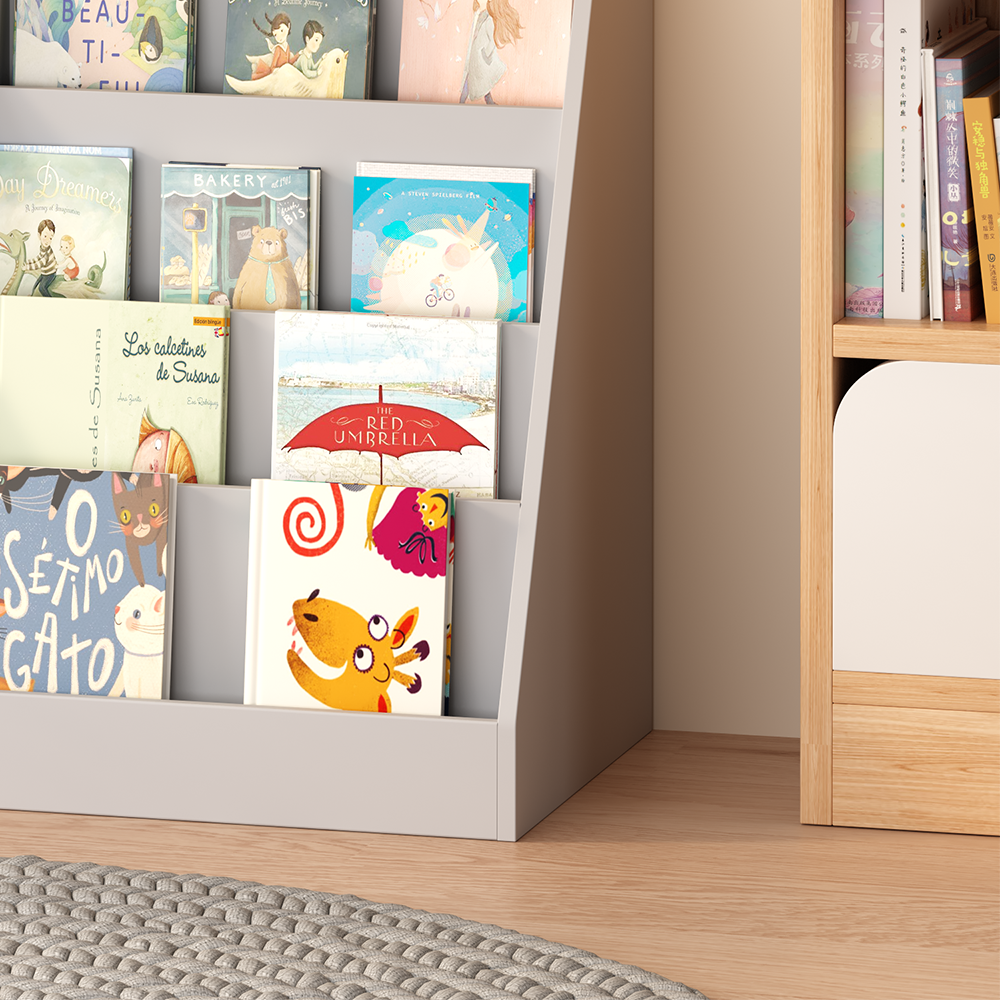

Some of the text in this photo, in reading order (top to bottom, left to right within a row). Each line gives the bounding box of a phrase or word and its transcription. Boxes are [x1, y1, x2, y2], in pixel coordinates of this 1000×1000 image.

[82, 39, 120, 63] TI-
[33, 160, 122, 214] Dreamers
[194, 174, 267, 188] BAKERY
[123, 331, 207, 358] Los calcetines
[89, 329, 101, 439] de Susana
[156, 361, 220, 384] de Susana
[376, 406, 393, 415] THE
[367, 416, 403, 431] RED
[334, 430, 437, 447] UMBRELLA
[65, 489, 97, 557] O
[4, 530, 124, 621] SÉTIMO
[3, 612, 115, 695] GATO
